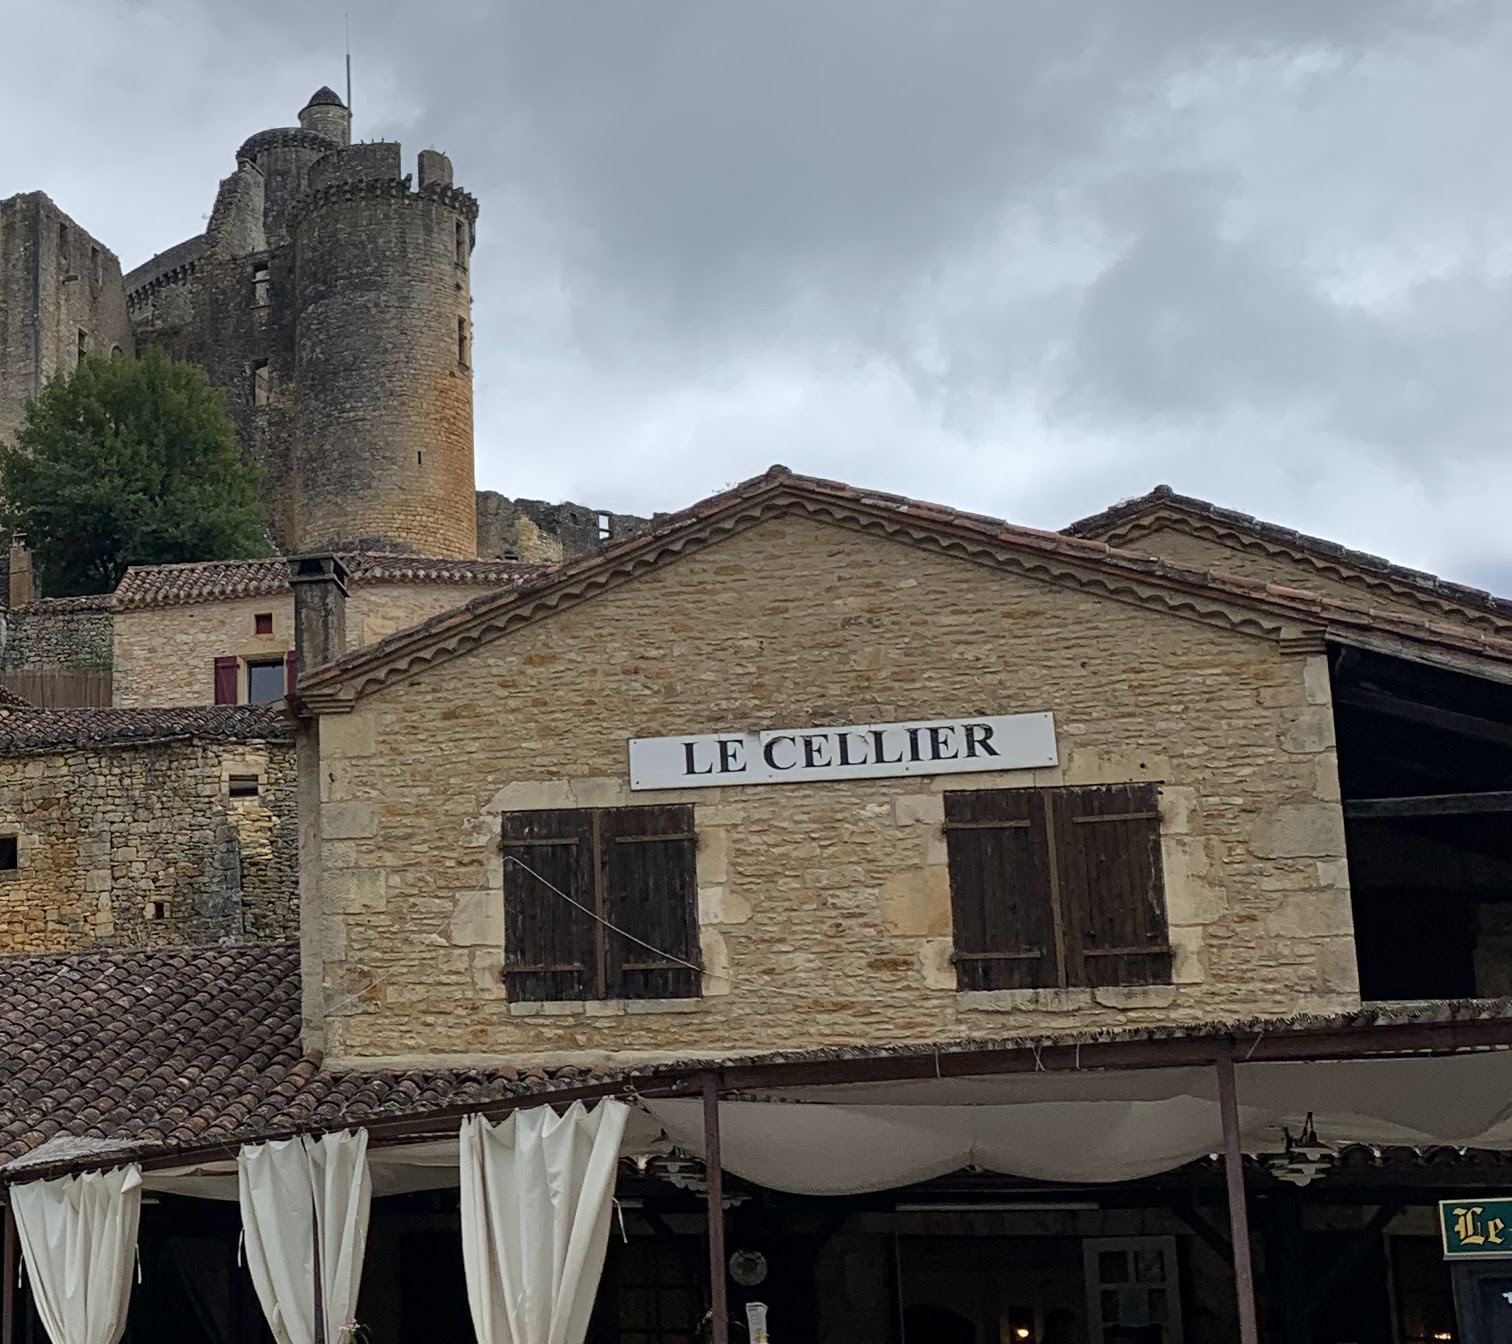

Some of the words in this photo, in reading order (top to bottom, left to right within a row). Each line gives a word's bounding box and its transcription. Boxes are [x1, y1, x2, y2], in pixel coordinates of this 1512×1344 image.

[681, 739, 748, 776] LE
[763, 723, 1001, 771] CELLIER
[1452, 1207, 1505, 1246] Le
